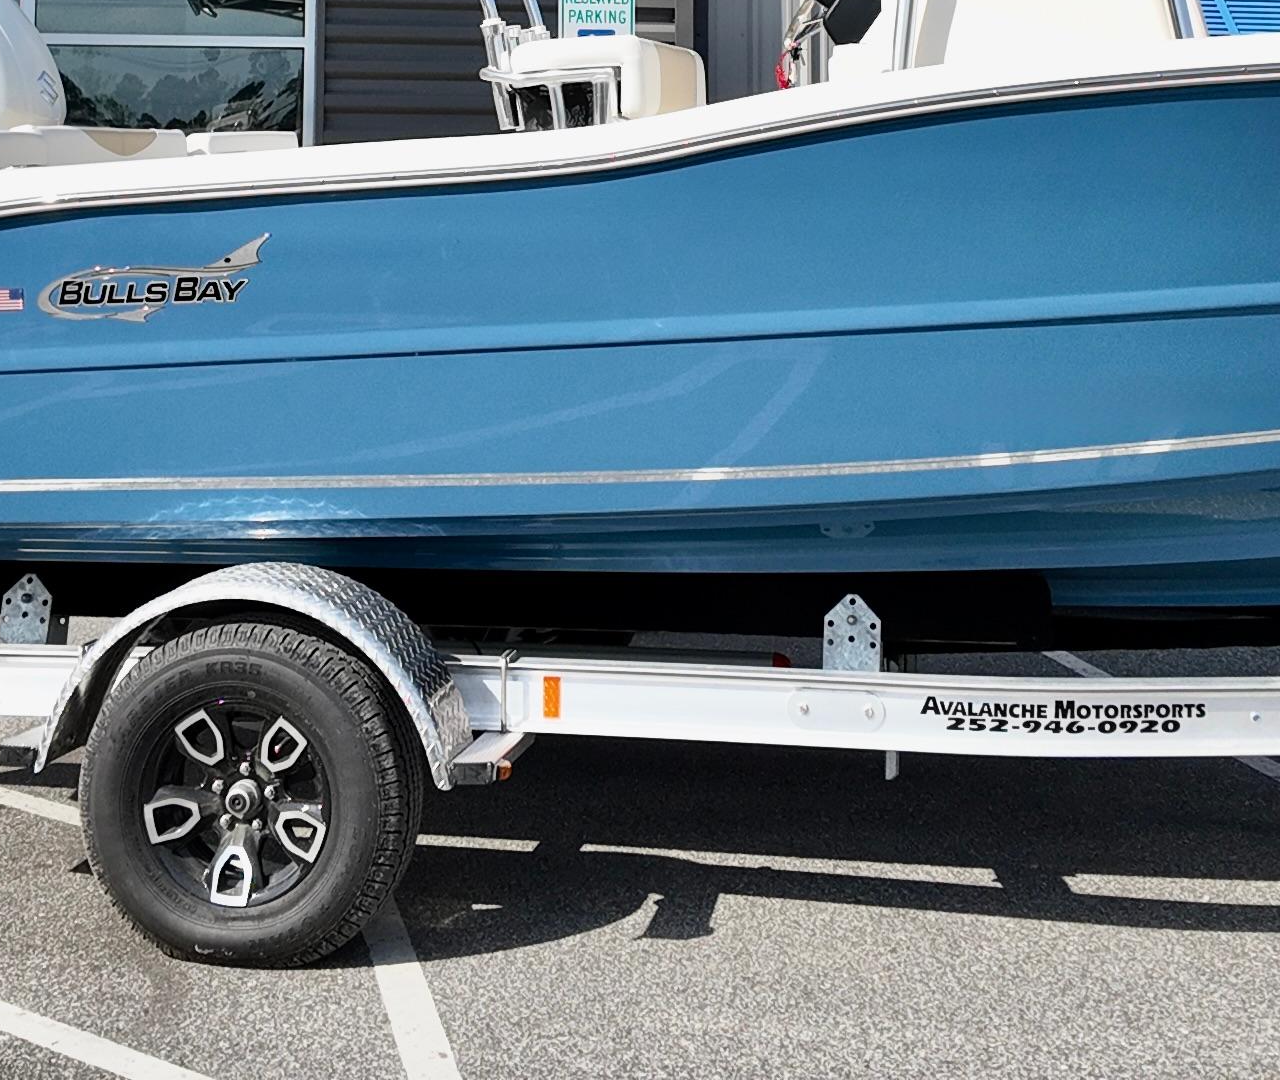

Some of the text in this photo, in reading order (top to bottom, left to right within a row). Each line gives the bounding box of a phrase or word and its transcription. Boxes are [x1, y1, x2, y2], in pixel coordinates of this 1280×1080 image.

[568, 10, 627, 24] PARKING
[58, 276, 249, 306] BULLS BAY
[920, 696, 1207, 719] AVALANCHE MOTORSPORTS
[946, 717, 1181, 734] 252-946-0920
